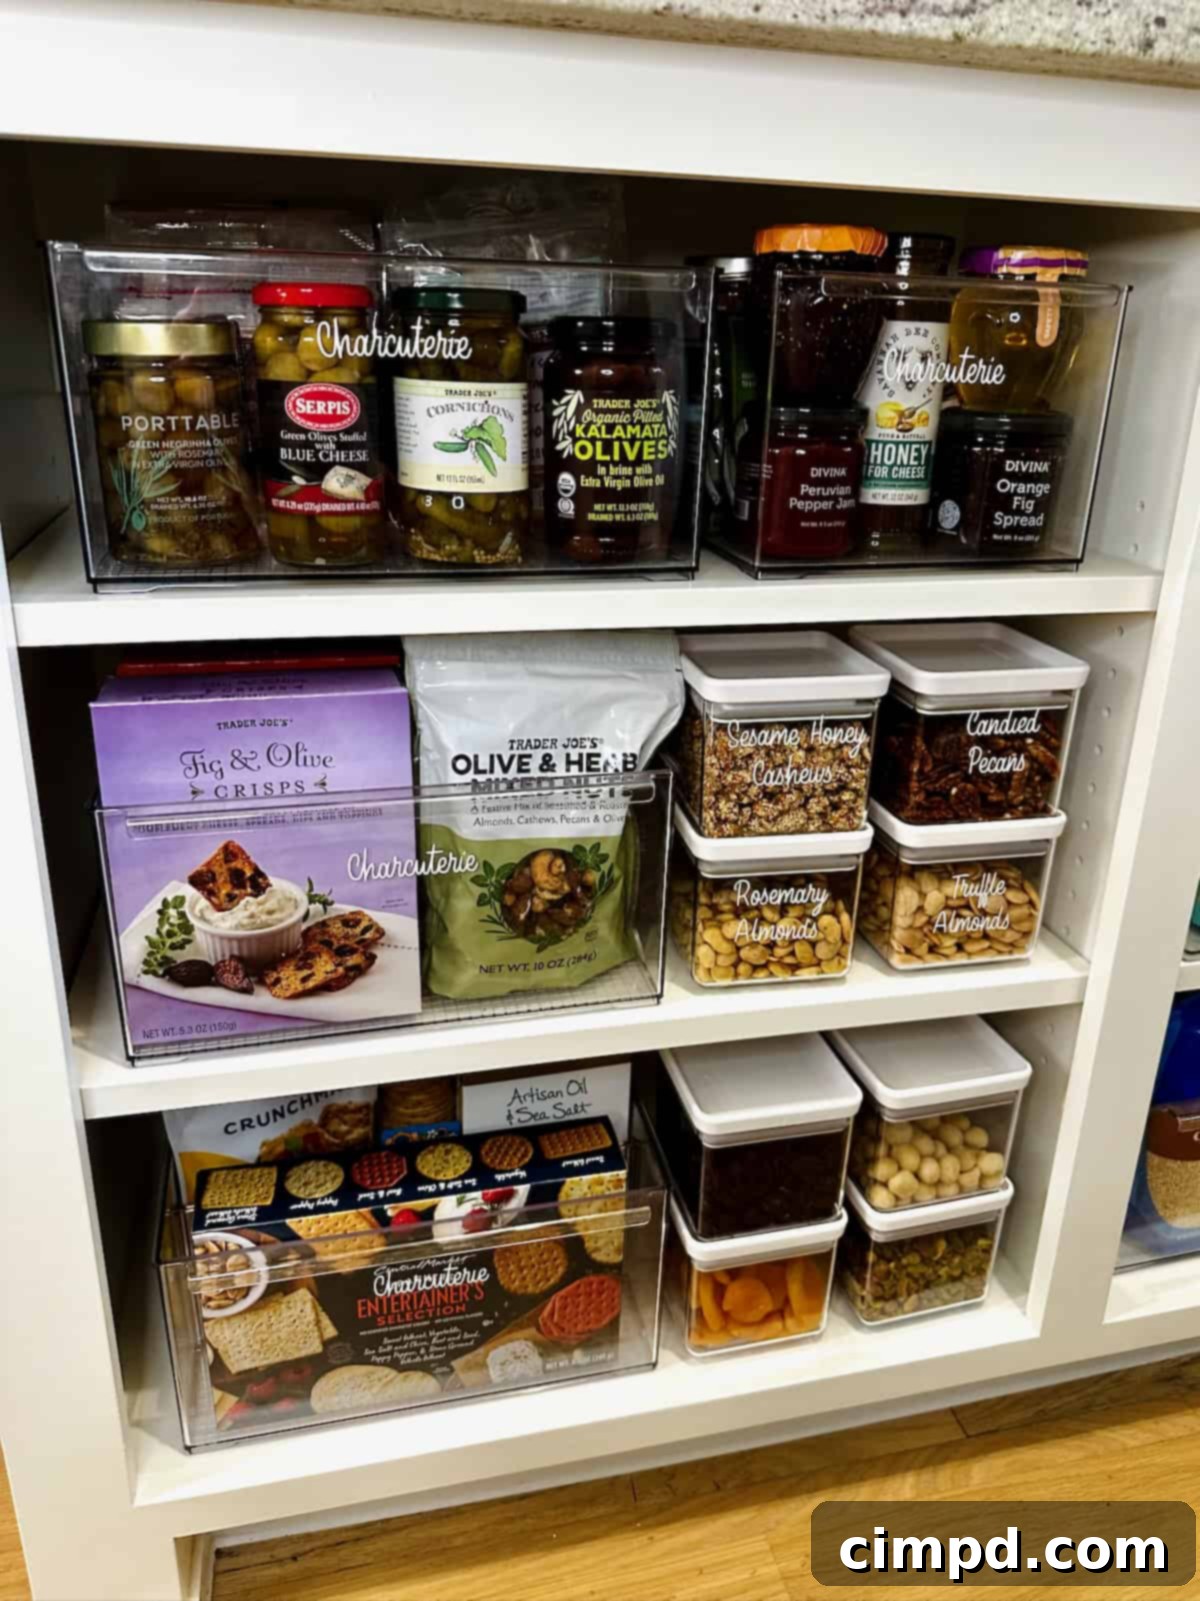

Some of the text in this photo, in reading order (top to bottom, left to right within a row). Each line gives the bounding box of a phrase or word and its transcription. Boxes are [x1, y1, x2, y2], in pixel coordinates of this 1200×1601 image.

[317, 311, 472, 360] Charcuterie
[883, 345, 1006, 385] Charcuterie
[296, 398, 351, 416] SERPIS
[593, 399, 630, 409] TRADER
[121, 413, 239, 432] PORTTABLE
[581, 408, 631, 427] Organic
[280, 430, 306, 441] Green
[575, 424, 668, 438] KALAMATA
[280, 448, 370, 462] BLUE CHEESE
[574, 439, 668, 461] OLIVES
[869, 443, 930, 466] HONEY
[810, 467, 847, 477] DIVINA
[867, 465, 926, 479] FOR CHEESE
[1005, 460, 1050, 472] DIVINA
[580, 474, 601, 488] Extra
[603, 475, 631, 491] Virgin
[633, 475, 653, 488] Olive
[800, 484, 851, 496] Peruvian
[996, 478, 1050, 497] Orange
[789, 498, 833, 512] Pepper
[1012, 496, 1035, 513] Fig
[993, 512, 1044, 529] Spread
[216, 719, 256, 730] TRADER
[966, 709, 1041, 737] Candied
[509, 738, 603, 751] TRADER JOE'S
[727, 714, 867, 759] Sesame Honey
[180, 741, 336, 780] Fig & Olive
[451, 752, 532, 775] OLIVE
[539, 752, 557, 773] &
[968, 745, 1026, 774] Pecans
[751, 761, 832, 789] Cashews
[214, 780, 305, 799] CRISPS
[347, 843, 480, 881] Charcuterie
[733, 878, 829, 916] Rosemary
[952, 873, 1006, 908] Truffle
[734, 918, 818, 942] Almonds
[933, 908, 1010, 934] Almonds
[479, 963, 504, 974] NET
[507, 963, 529, 973] WT.
[547, 957, 566, 969] OZ
[142, 1028, 159, 1040] NET
[195, 1023, 208, 1034] OZ
[507, 1077, 588, 1107] Artisan Oil
[516, 1106, 549, 1123] Sea
[553, 1102, 592, 1119] Salt
[374, 1263, 490, 1297] Charcuterie
[357, 1281, 485, 1319] ENTERTAINER'S
[377, 1304, 467, 1326] SELECTION
